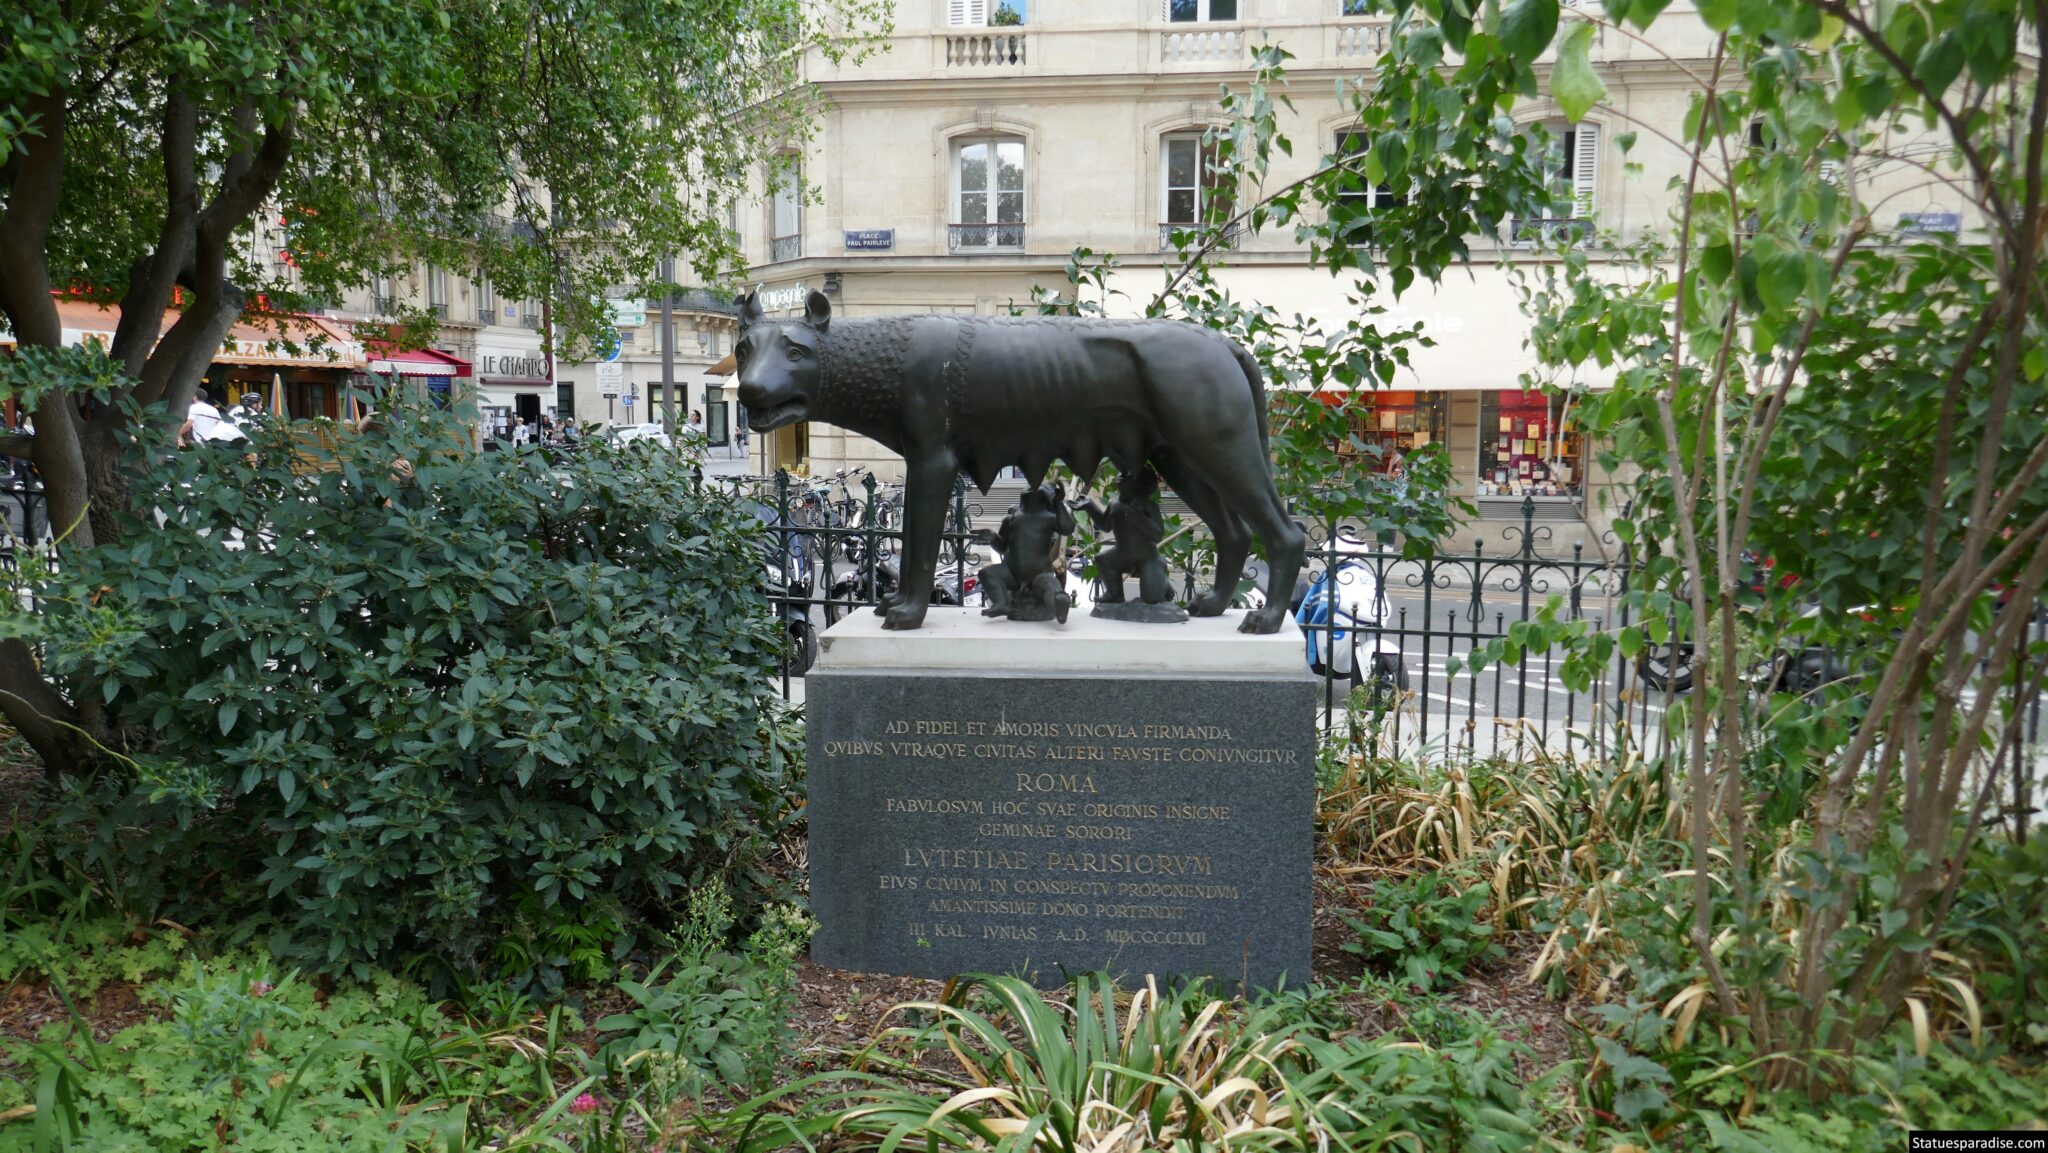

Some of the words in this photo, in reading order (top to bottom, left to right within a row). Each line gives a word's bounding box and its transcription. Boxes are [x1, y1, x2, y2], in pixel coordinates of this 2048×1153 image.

[484, 355, 496, 374] LE
[500, 355, 549, 377] CHAMPO
[885, 720, 909, 734] AD
[916, 721, 958, 735] FIDEI
[967, 721, 986, 735] ET
[993, 722, 1059, 737] AMORIS
[1066, 723, 1137, 738] VINCVLA
[1144, 725, 1232, 740] FIRMANDA
[824, 742, 883, 757] QVIBVS
[890, 742, 966, 759] VTRAQVE
[974, 744, 1036, 758] CIVITAS
[1045, 745, 1104, 760] ALTERI
[1112, 747, 1172, 761] FAVSTE
[1179, 748, 1298, 764] CONIVNGITVR
[1016, 773, 1098, 793] ROMA
[886, 798, 984, 814] FABVLOSVM
[992, 801, 1029, 815] HOC
[1037, 802, 1077, 816] SVAE
[1083, 803, 1158, 818] ORIGINIS
[1165, 805, 1231, 820] INSIGNE
[979, 823, 1056, 838] GEMINAE
[1065, 825, 1132, 841] SORORI
[904, 848, 1028, 869] LVTETIAE
[1048, 852, 1212, 876] PARISIORVM
[880, 875, 918, 889] EIVS
[926, 877, 982, 891] CIVIVM
[990, 878, 1007, 893] IN
[1014, 880, 1110, 895] CONSPECTV
[1118, 882, 1240, 899] PROPONENDVM
[928, 899, 1036, 914] AMANTISSIME
[1042, 902, 1088, 917] DONO
[1096, 904, 1185, 920] PORTENDIT
[908, 922, 925, 935] III
[935, 923, 972, 938] KAL.
[983, 925, 1037, 940] IVNIAS
[1105, 928, 1206, 945] MDCCCCLXII
